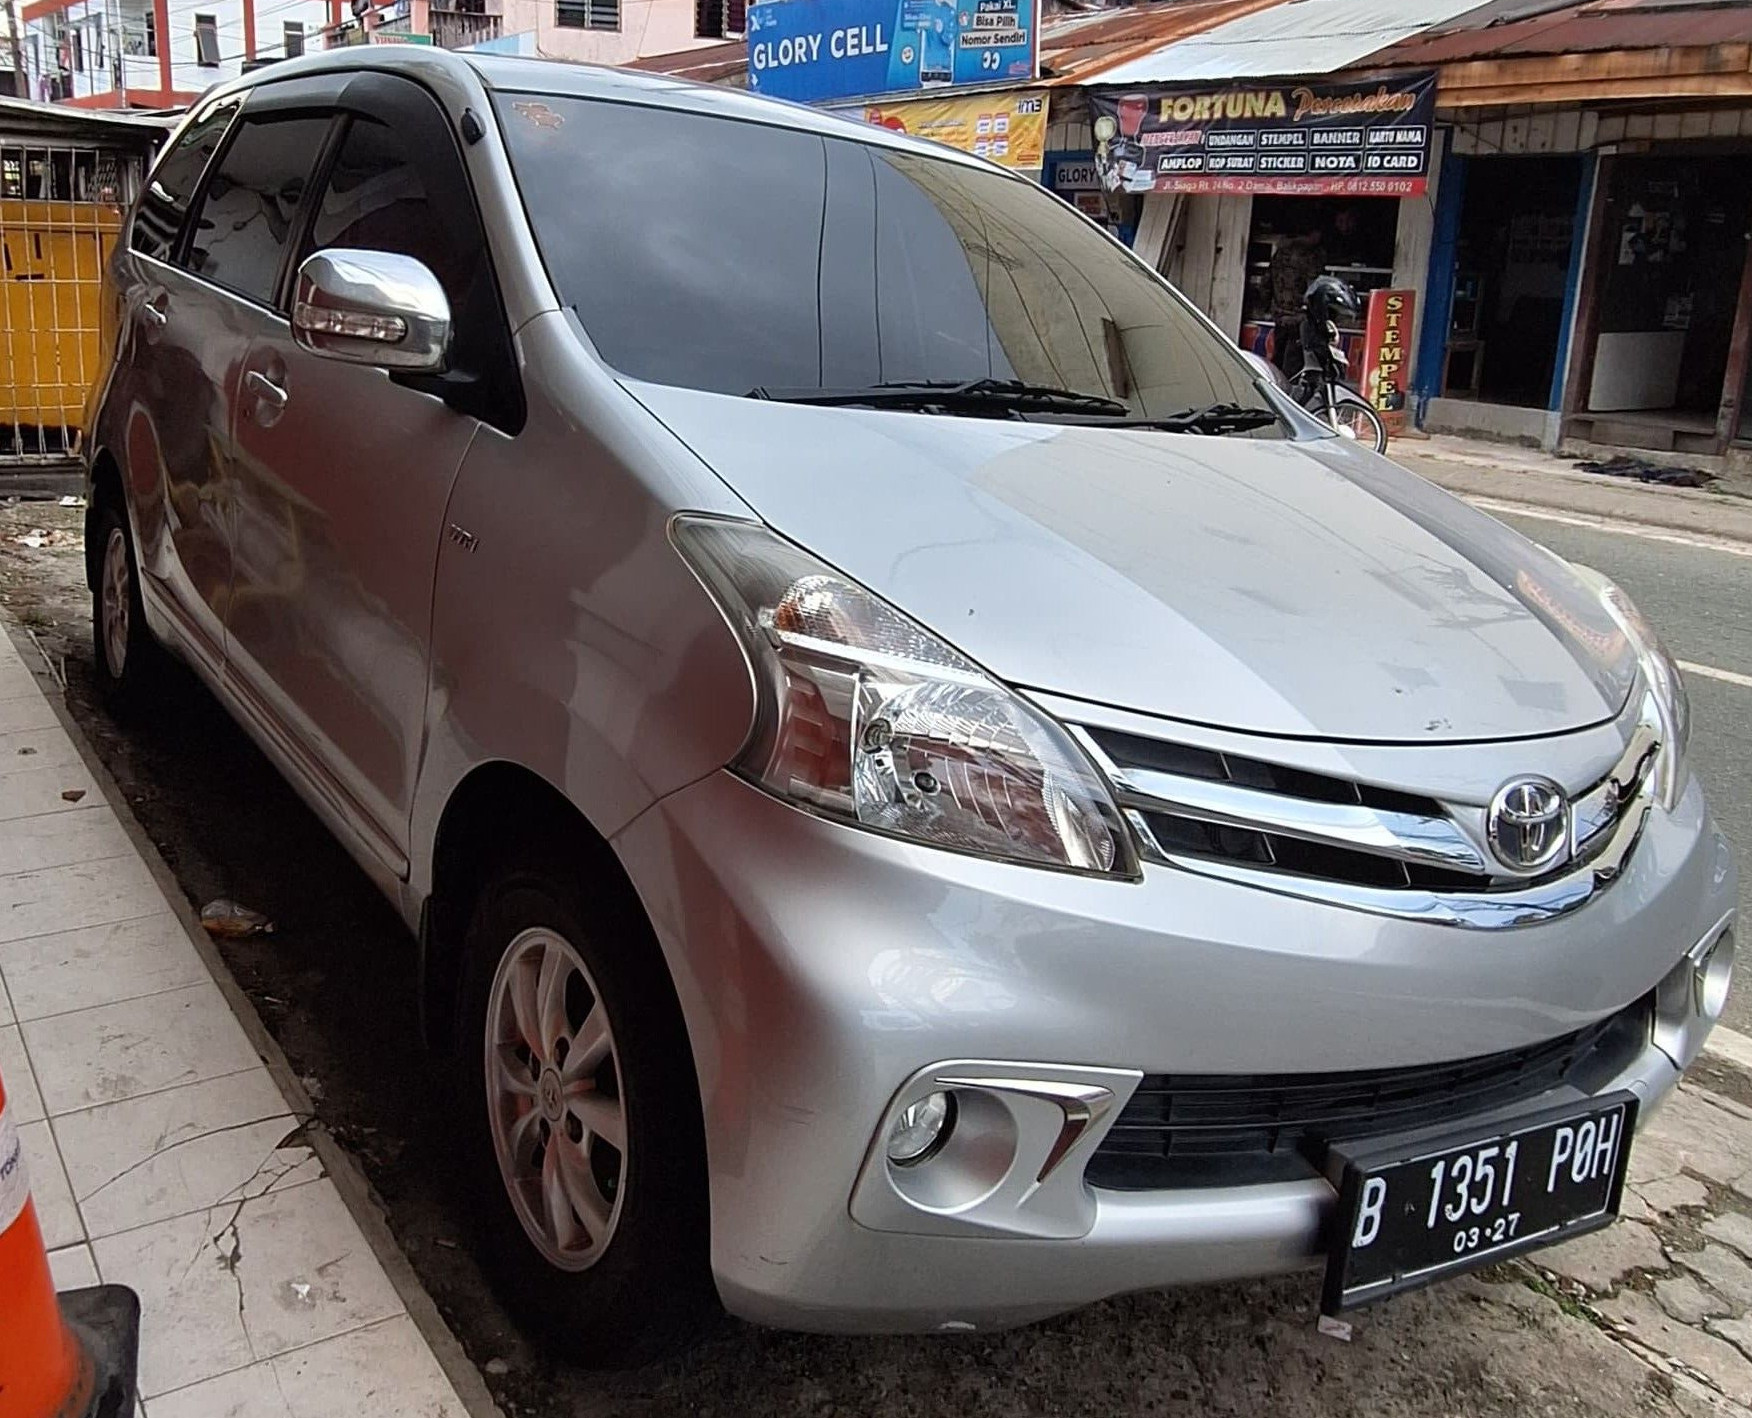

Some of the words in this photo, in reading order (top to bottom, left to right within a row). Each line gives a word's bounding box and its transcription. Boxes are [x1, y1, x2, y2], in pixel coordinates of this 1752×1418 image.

[976, 16, 994, 26] Bisa
[997, 16, 1015, 26] Pilih
[962, 35, 991, 45] Nomor
[993, 32, 1026, 44] Sendiri
[753, 33, 822, 70] GLORY
[830, 23, 889, 58] CELL
[1159, 91, 1286, 122] FORTUNA
[1208, 134, 1254, 146] UNDANGAN
[1260, 132, 1304, 145] STEMPEL
[1313, 131, 1361, 144] BANNER
[1369, 130, 1394, 143] KARTU
[1396, 130, 1422, 143] NAMA
[1161, 158, 1202, 169] AMPLOP
[1209, 157, 1226, 169] KOP
[1227, 157, 1254, 168] SURAT
[1260, 156, 1304, 168] STICKER
[1315, 156, 1356, 168] NOTA
[1367, 156, 1381, 168] ID
[1383, 156, 1418, 168] CARD
[1058, 168, 1096, 183] GLORY
[1378, 296, 1403, 411] STEMPEL
[1352, 1176, 1387, 1249] B
[1427, 1140, 1519, 1230] 1351
